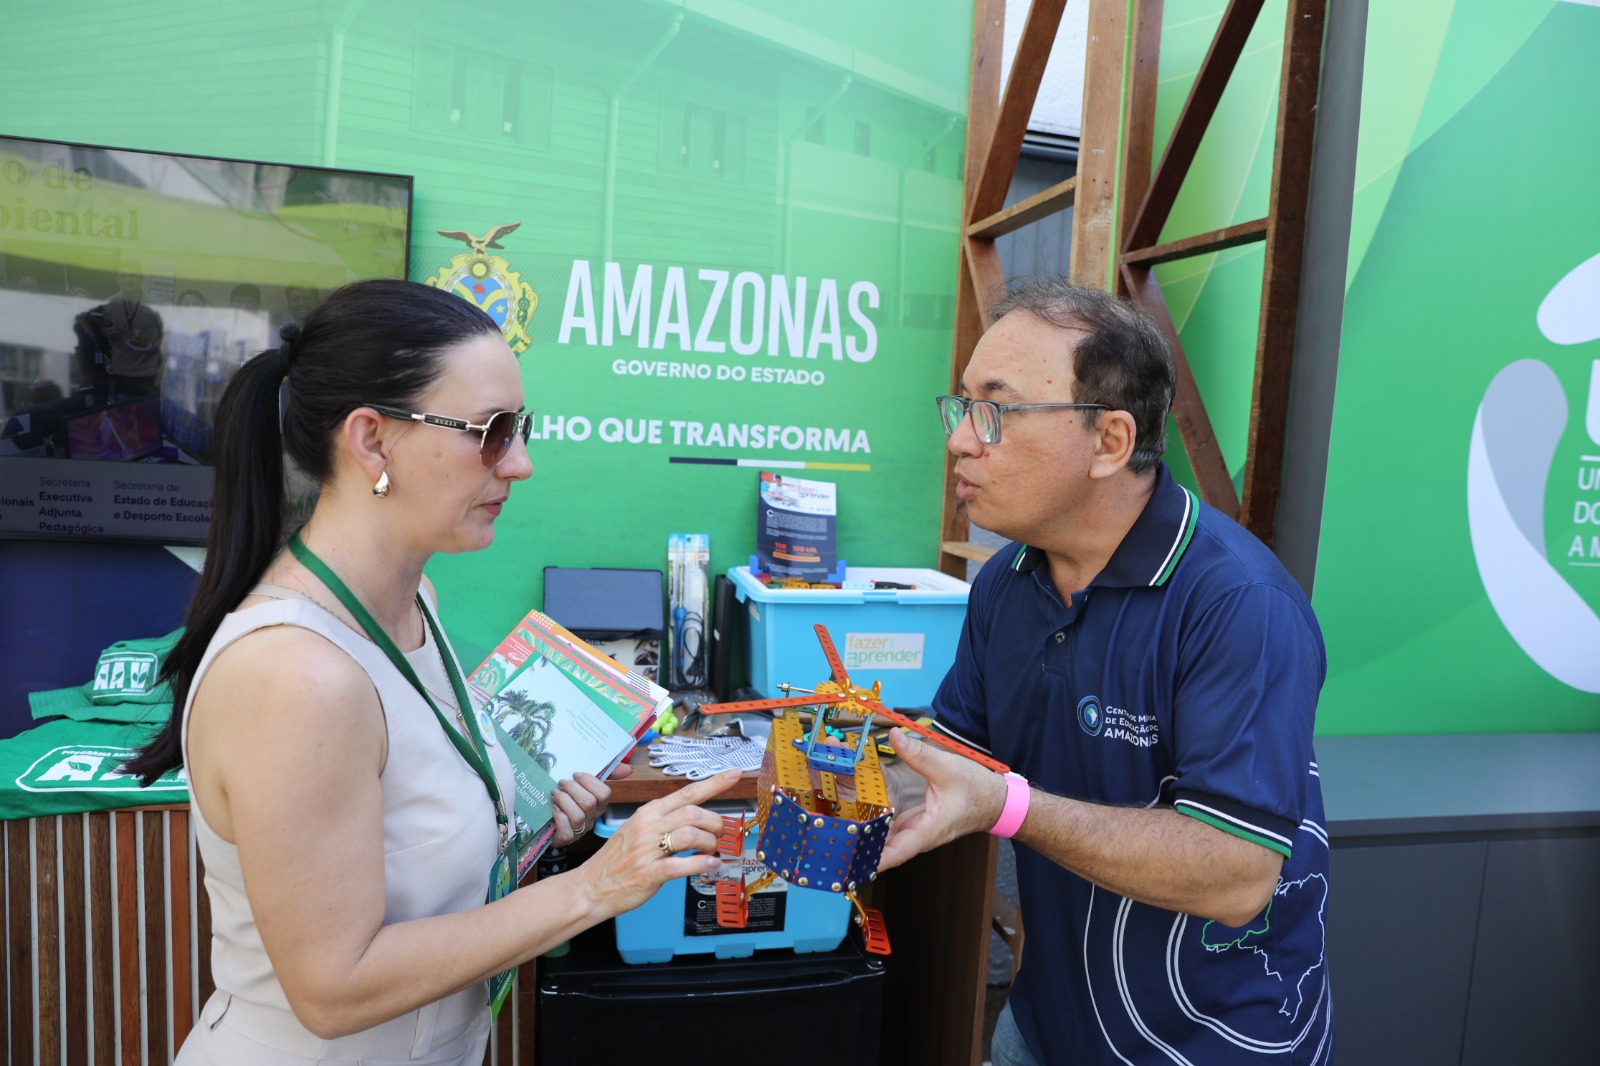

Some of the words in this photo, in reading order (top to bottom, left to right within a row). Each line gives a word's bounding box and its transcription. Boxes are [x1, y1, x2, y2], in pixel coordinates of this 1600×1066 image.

[43, 157, 94, 191] de
[558, 259, 880, 362] AMAZONAS
[612, 359, 711, 380] GOVERNO
[716, 365, 747, 381] DO
[751, 367, 825, 386] ESTADO
[530, 415, 592, 442] LHO
[598, 417, 663, 443] QUE
[669, 420, 871, 453] TRANSFORMA
[39, 476, 91, 488] Secretaria
[114, 480, 164, 492] Secretaria
[166, 482, 180, 492] de
[0, 495, 35, 507] ionais
[39, 491, 93, 504] Executiva
[114, 495, 151, 506] Estado
[153, 497, 167, 506] de
[38, 507, 82, 520] Adjunta
[123, 511, 173, 523] Desporto
[176, 513, 211, 524] Escola
[39, 522, 104, 535] Pedagógica
[1568, 535, 1584, 557] A
[848, 634, 889, 649] fazer
[516, 771, 548, 806] Pupunha
[742, 865, 769, 875] apren
